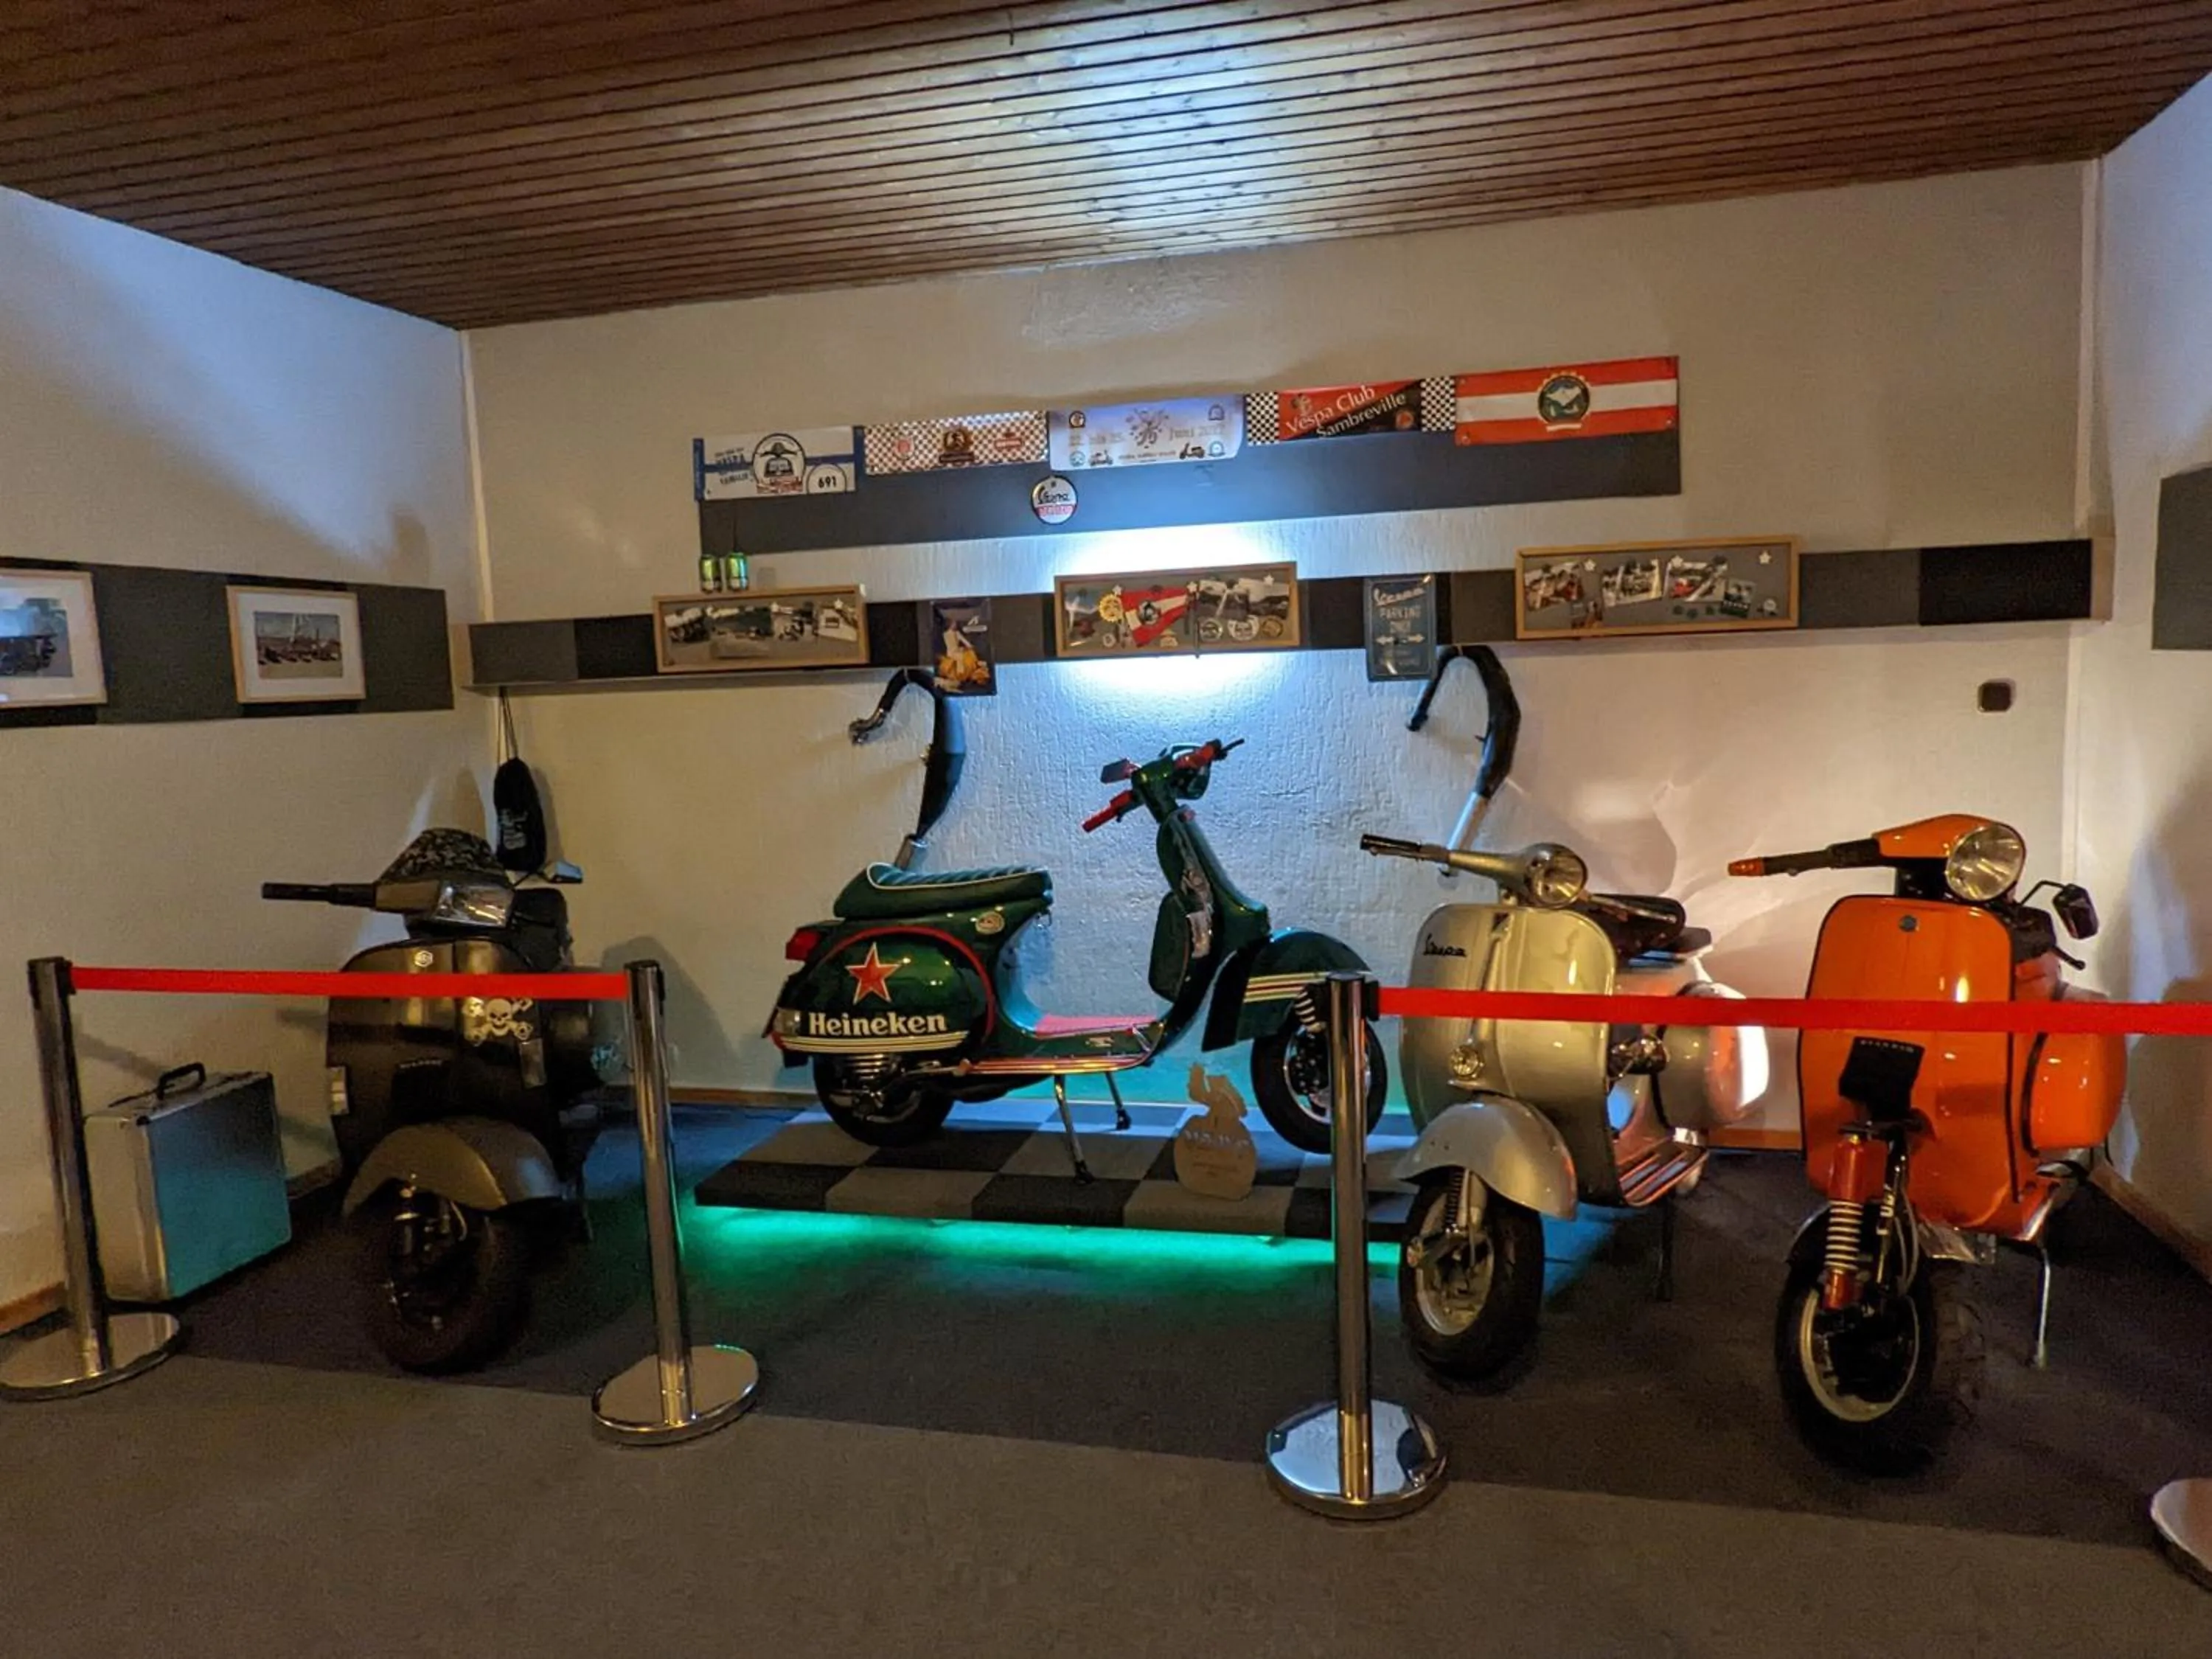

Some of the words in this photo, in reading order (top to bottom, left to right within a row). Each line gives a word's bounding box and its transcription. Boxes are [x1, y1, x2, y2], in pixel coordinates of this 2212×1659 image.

[1285, 406, 1334, 433] Vespa
[1336, 384, 1375, 412] Club
[1316, 393, 1406, 438] Sambreville
[818, 476, 836, 488] 691
[1423, 933, 1467, 958] Vespa
[808, 1012, 947, 1036] Heineken
